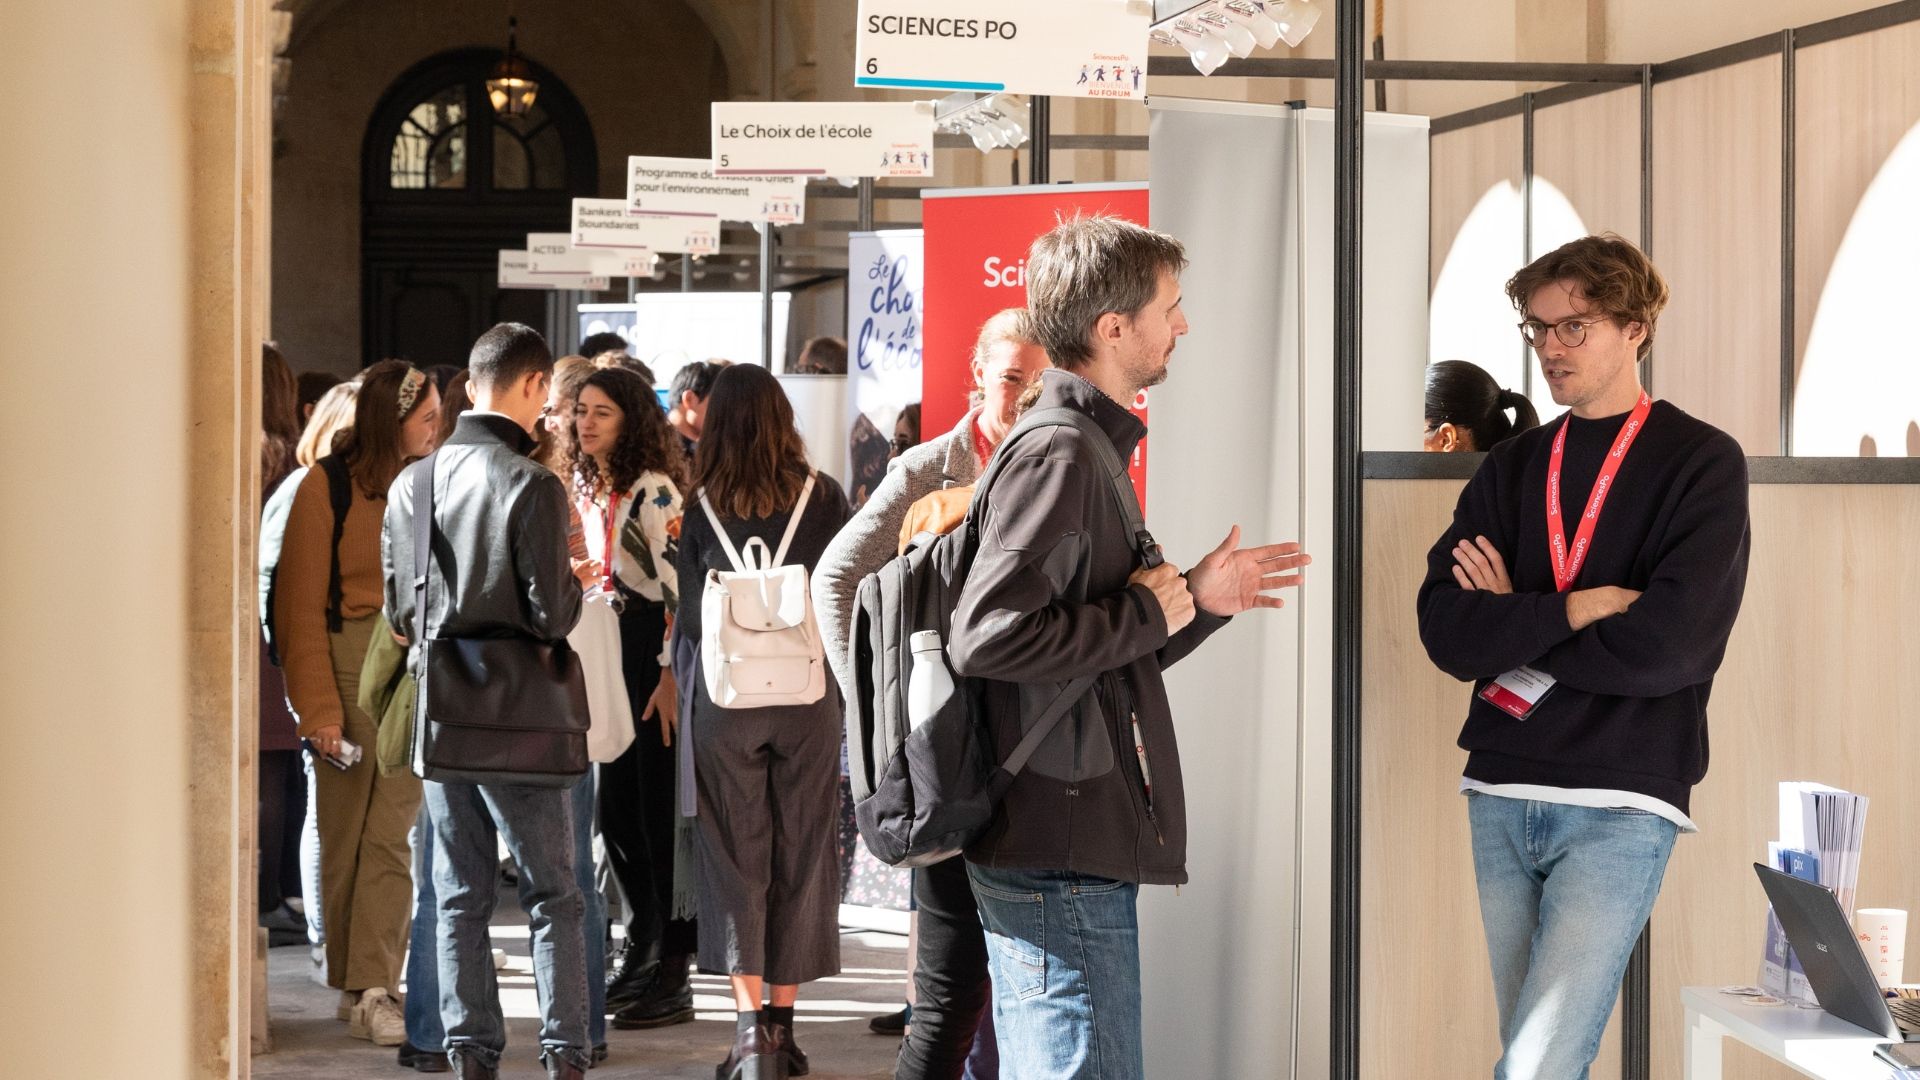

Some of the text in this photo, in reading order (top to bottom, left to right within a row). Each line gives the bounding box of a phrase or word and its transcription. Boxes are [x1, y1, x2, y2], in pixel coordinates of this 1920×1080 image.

[868, 15, 1017, 40] SCIENCES PO
[866, 57, 878, 75] 6
[1101, 89, 1131, 97] FORUM
[720, 124, 873, 139] Le Choix de l'école
[720, 154, 729, 167] 5
[635, 166, 699, 180] Programme
[701, 167, 719, 181] de
[634, 183, 750, 196] pour l'environnement
[634, 197, 641, 208] 4
[578, 206, 622, 217] Bankers
[578, 219, 640, 230] Boundaries
[532, 245, 566, 255] ACTED
[1612, 419, 1639, 459] SciencesPo
[1550, 471, 1558, 516] SciencesPo
[1587, 474, 1610, 520] SciencesPo
[1566, 537, 1587, 582] SciencesPo
[1793, 855, 1804, 873] pix
